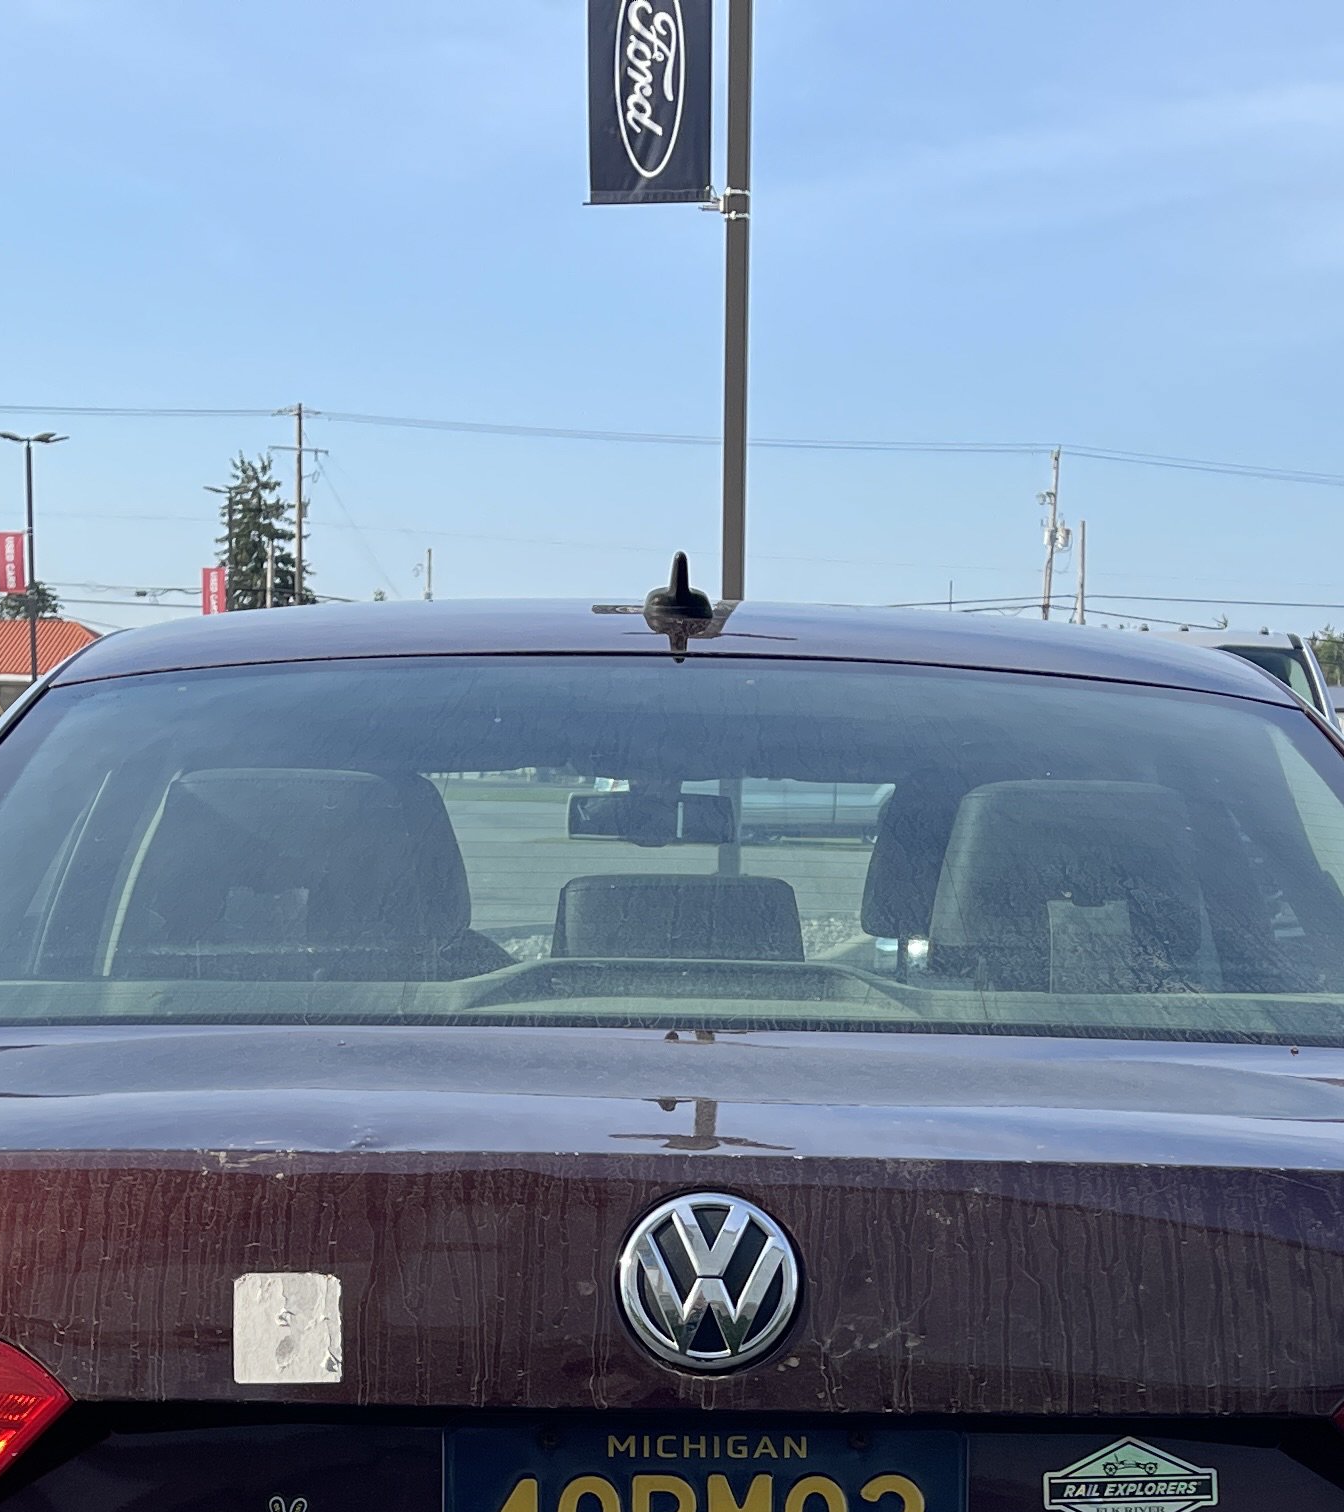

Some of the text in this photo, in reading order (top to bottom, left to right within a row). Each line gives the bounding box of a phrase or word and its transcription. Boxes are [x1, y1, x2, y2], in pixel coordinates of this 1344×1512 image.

[627, 0, 676, 136] Ford
[5, 536, 16, 590] USED CARS
[608, 1435, 807, 1458] MICHIGAN
[1063, 1482, 1197, 1497] RAIL EXPLORERS
